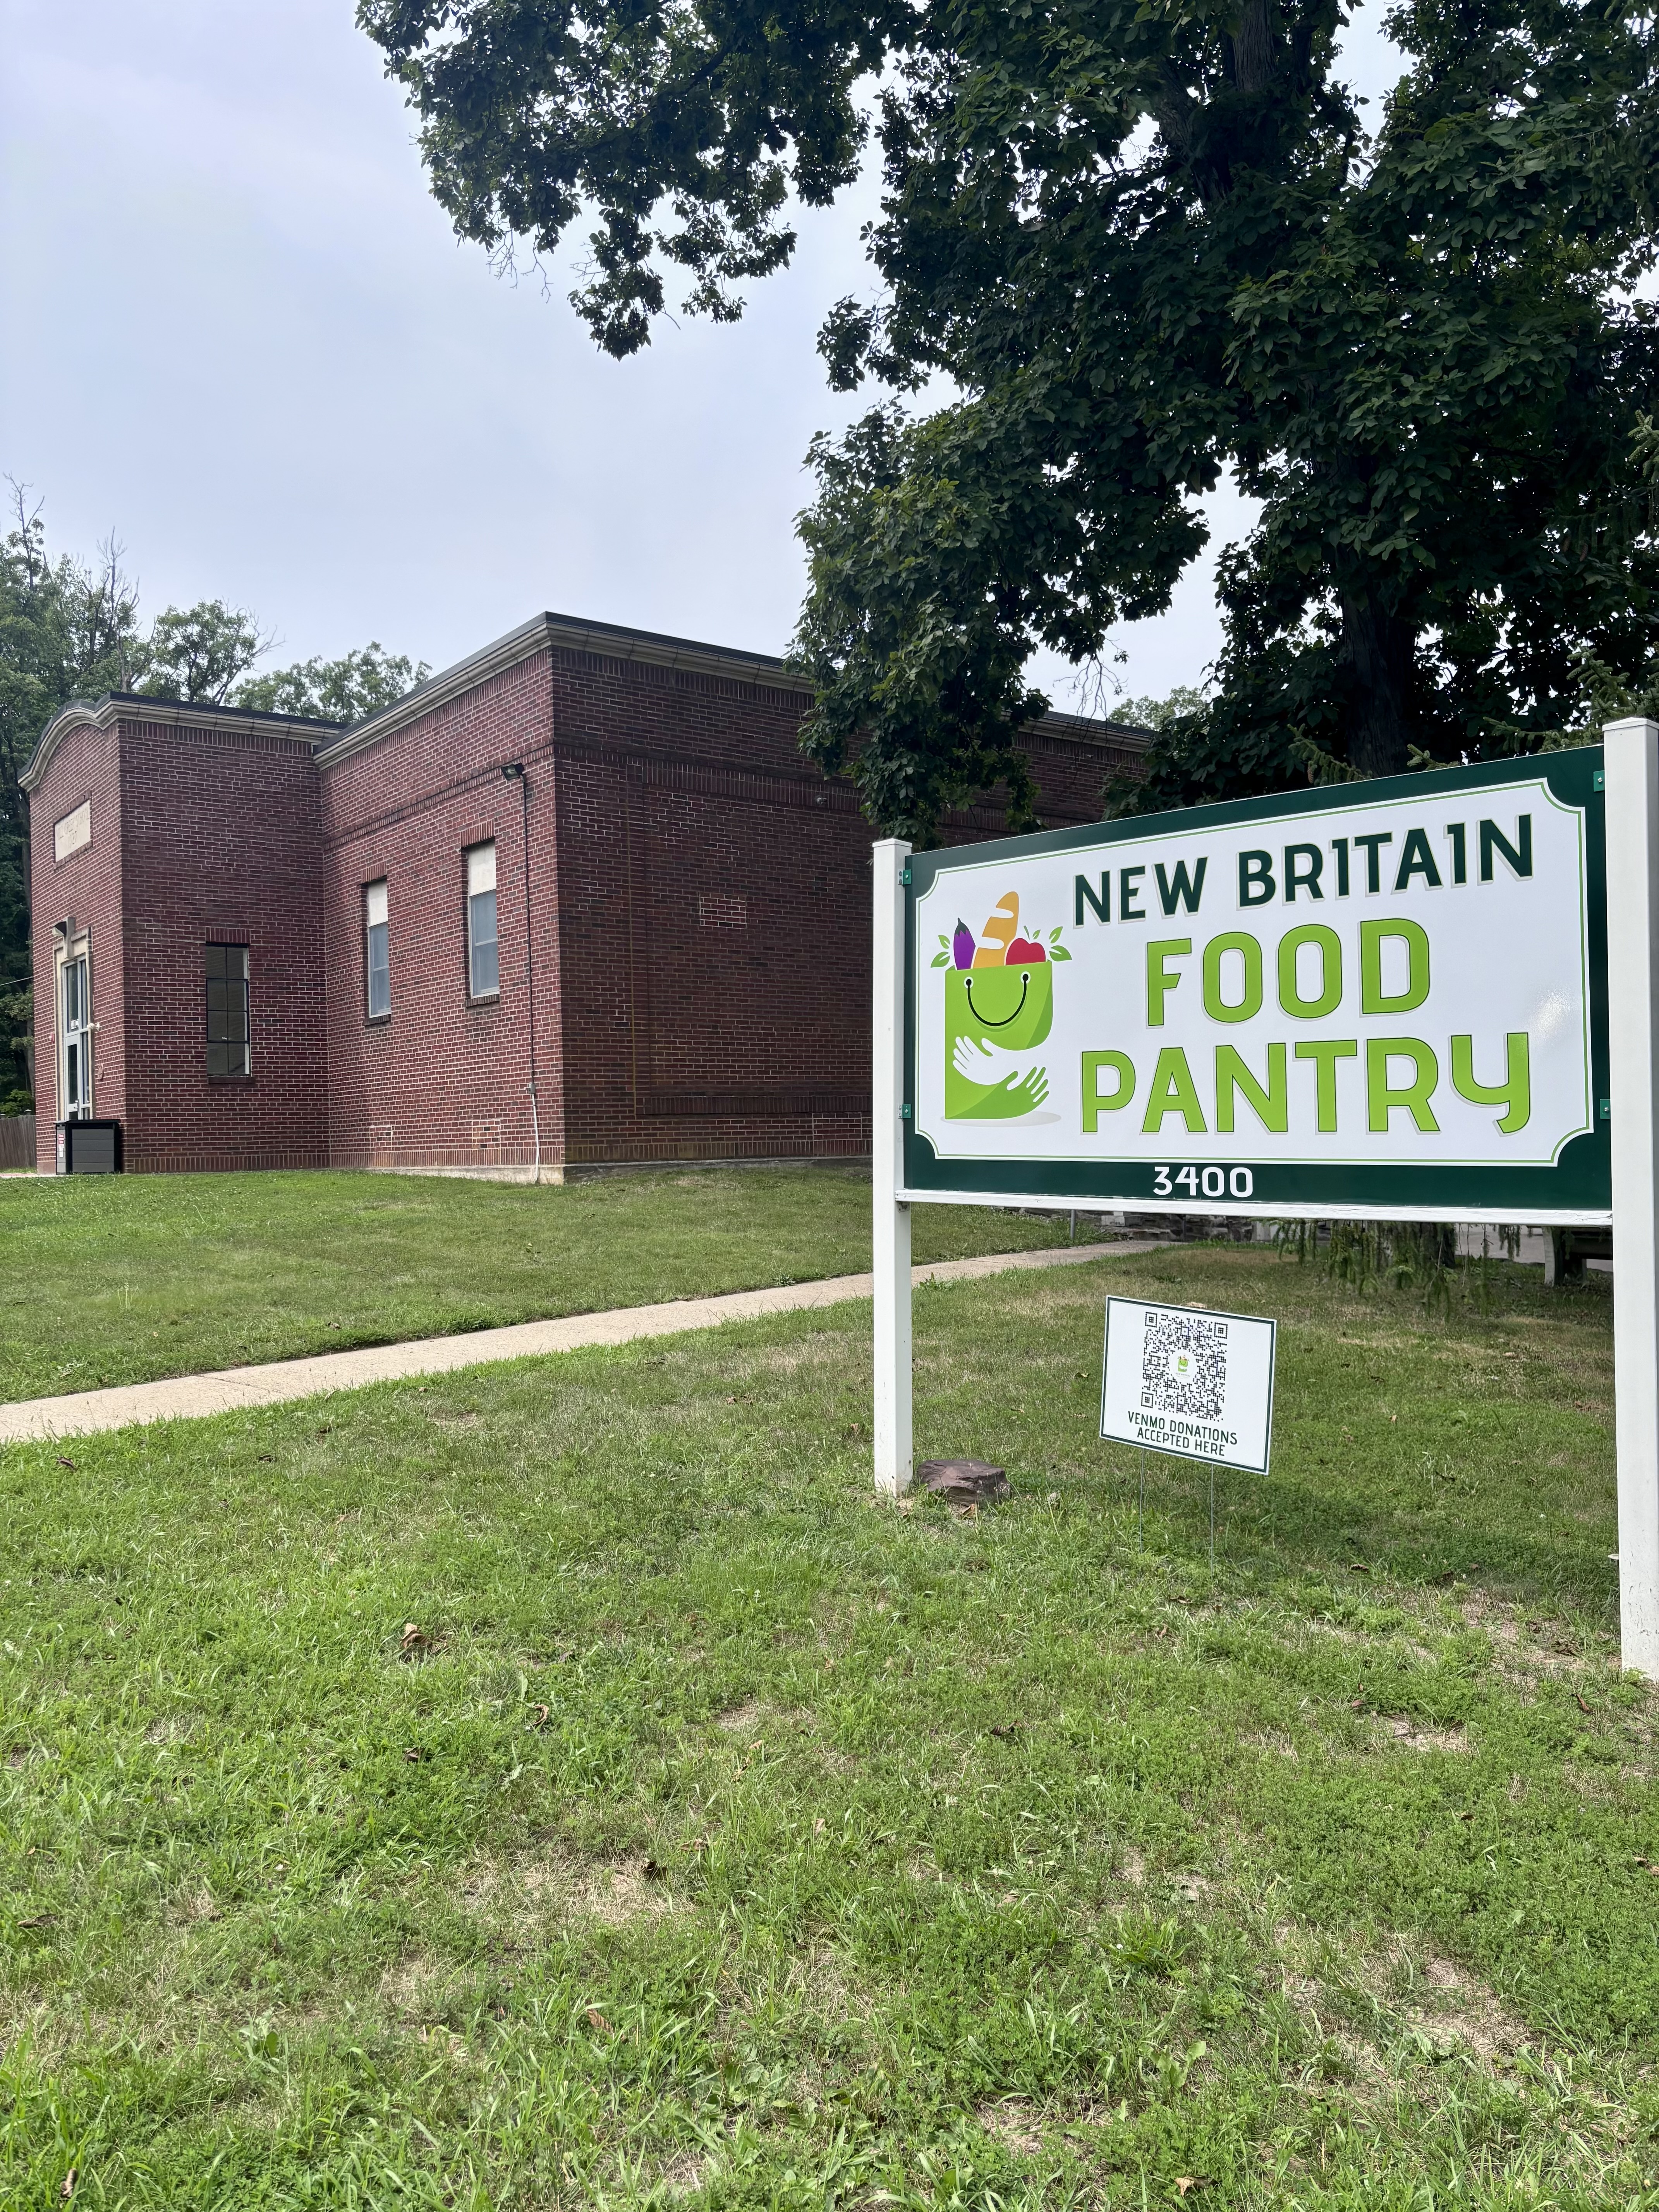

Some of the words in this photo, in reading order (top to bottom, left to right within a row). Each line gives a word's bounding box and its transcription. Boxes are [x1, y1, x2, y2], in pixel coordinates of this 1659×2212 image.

[1075, 857, 1208, 926] NEW
[1238, 814, 1533, 908] BRITAIN
[1147, 918, 1430, 1026] FOOD
[1081, 1032, 1531, 1134] PANTRY
[1153, 1166, 1253, 1198] 3400
[1128, 1411, 1165, 1430] VENMO
[1170, 1420, 1237, 1445] DONATIONS
[1137, 1427, 1189, 1448] ACCEPTED
[1195, 1439, 1225, 1456] HERE
